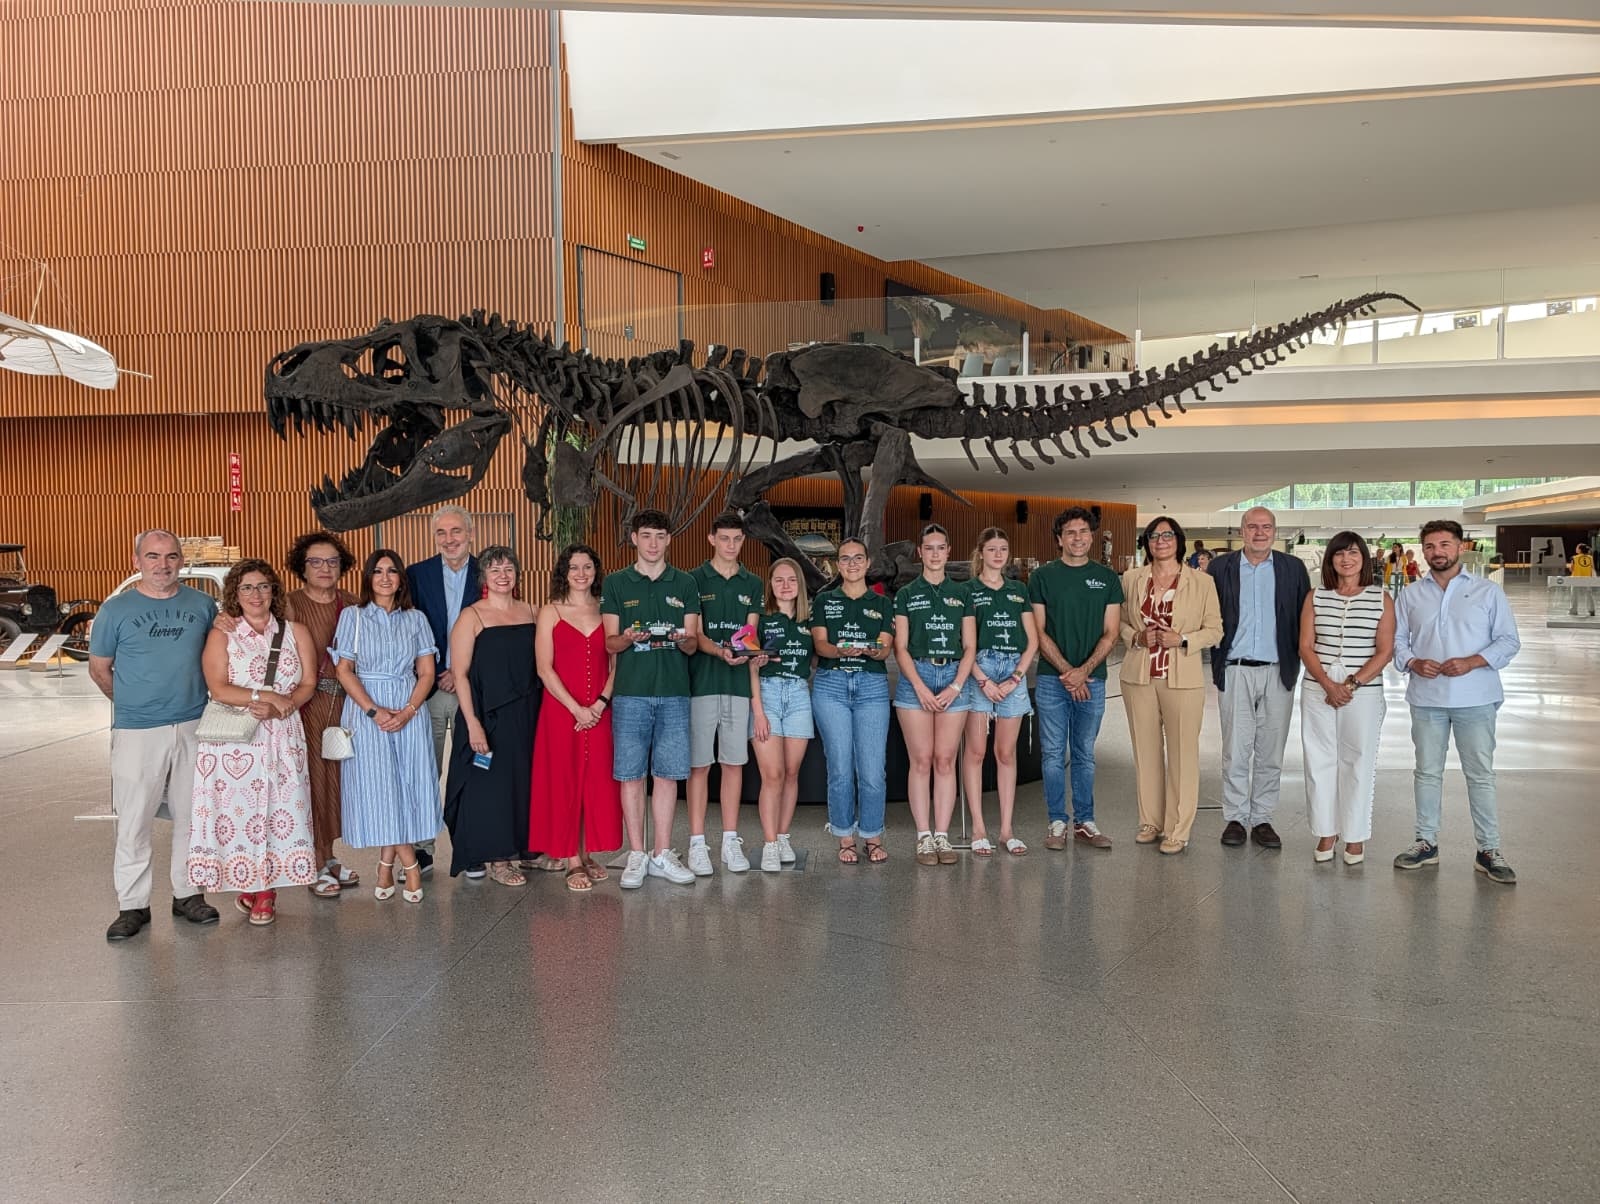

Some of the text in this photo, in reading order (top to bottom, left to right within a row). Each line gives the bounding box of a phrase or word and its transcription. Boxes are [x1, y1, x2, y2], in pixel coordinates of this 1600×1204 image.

[131, 609, 159, 629] MAKE
[176, 608, 196, 624] NEW
[925, 622, 954, 631] DIGASER
[986, 620, 1017, 628] DIGASER
[148, 621, 185, 642] living
[837, 630, 867, 639] DIGASER
[779, 648, 808, 657] DIGASER
